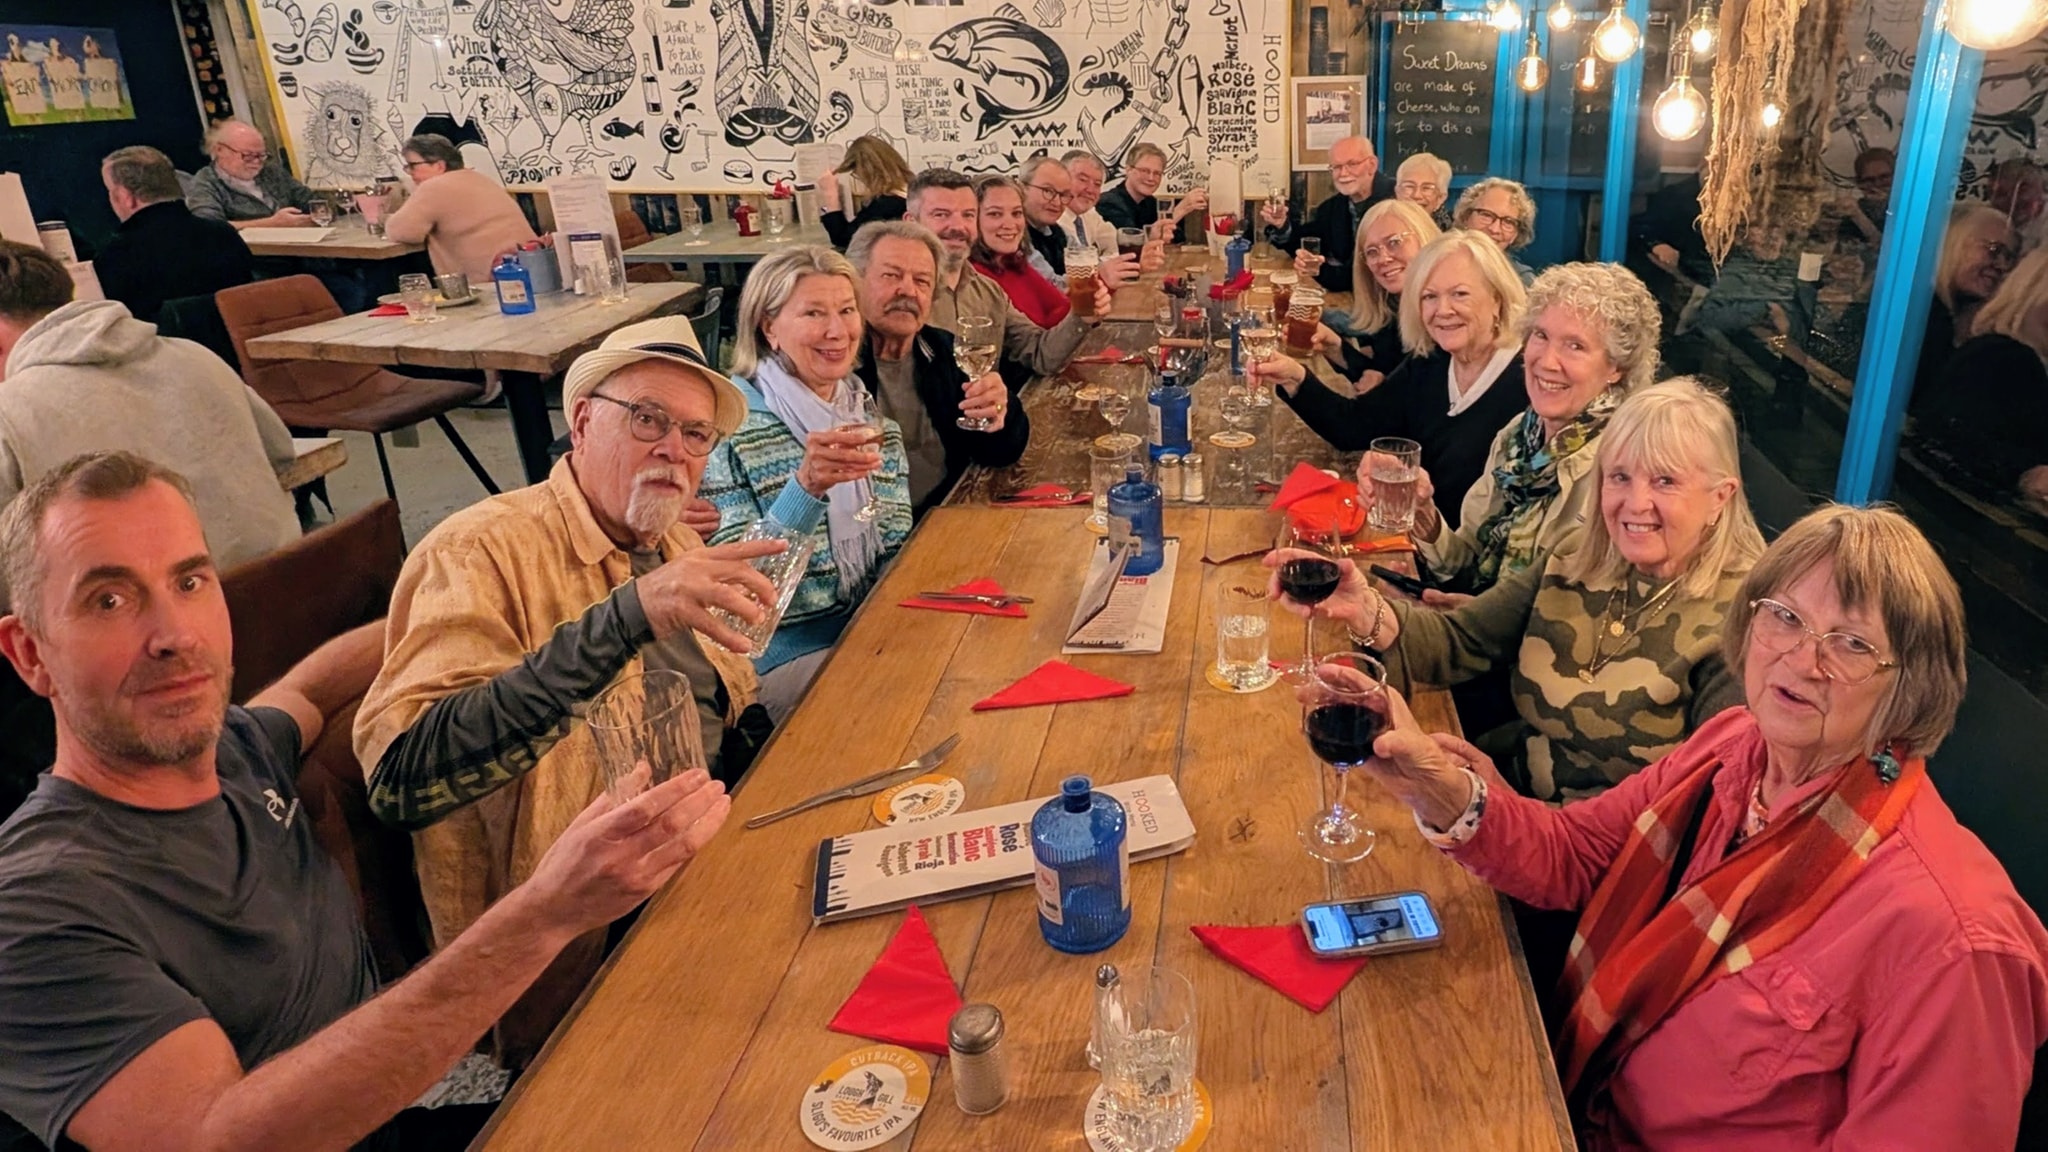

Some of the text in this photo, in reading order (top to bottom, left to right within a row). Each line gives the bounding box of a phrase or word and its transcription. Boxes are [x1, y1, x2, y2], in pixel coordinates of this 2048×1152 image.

[448, 34, 488, 59] Wine
[1402, 44, 1488, 72] Sweet Dreams
[1394, 80, 1477, 96] are made of
[1440, 101, 1461, 112] who
[1394, 120, 1473, 135] I to dis a
[914, 837, 932, 861] Syrah
[963, 828, 984, 862] Blanc
[999, 822, 1025, 853] Rosé
[914, 858, 945, 870] Rioja
[825, 1125, 882, 1142] FAVOURITE
[882, 1114, 903, 1131] IPA
